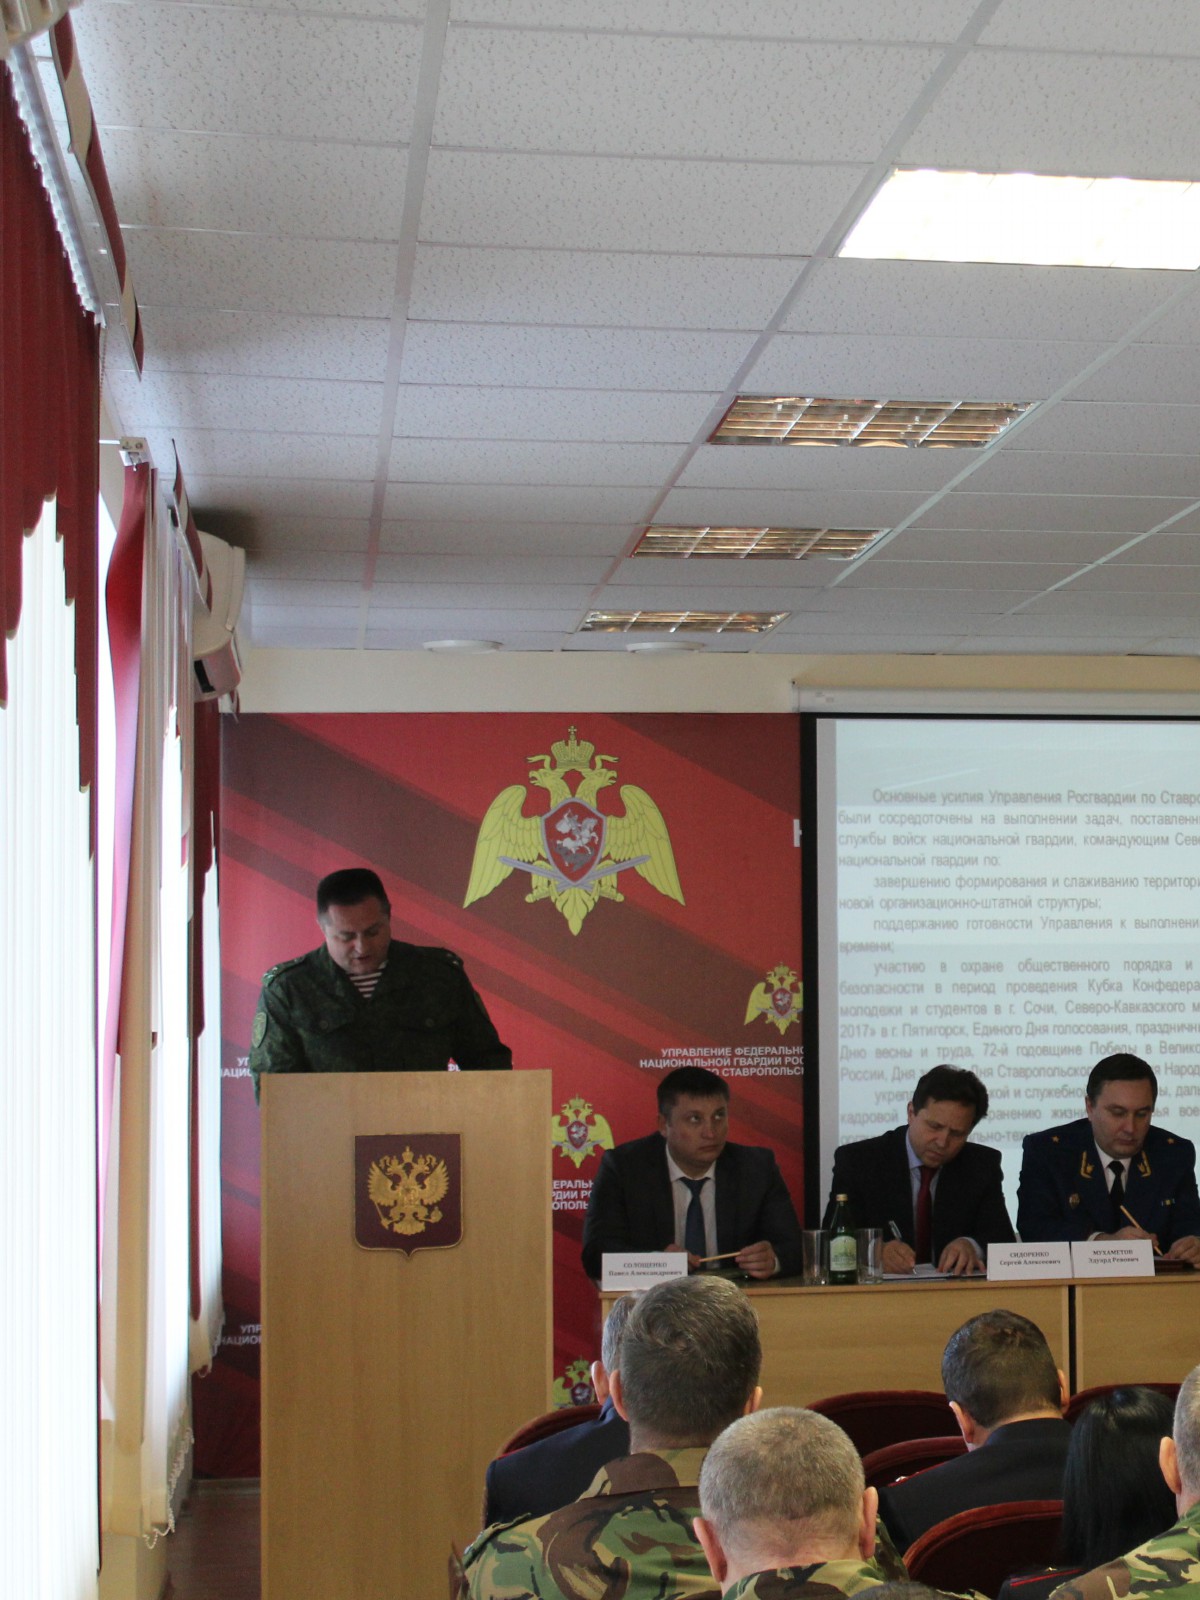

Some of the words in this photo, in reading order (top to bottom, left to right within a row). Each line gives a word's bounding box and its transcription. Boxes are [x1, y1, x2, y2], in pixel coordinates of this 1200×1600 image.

[873, 788, 936, 804] Основные
[941, 791, 984, 806] усилия
[989, 790, 1062, 806] Управления
[1067, 789, 1136, 807] Росгвардии
[1141, 793, 1156, 804] по
[838, 811, 871, 826] были
[879, 813, 973, 827] сосредоточены
[981, 814, 995, 825] на
[1004, 814, 1077, 825] выполнении
[838, 831, 886, 848] службы
[893, 831, 926, 845] войск
[933, 832, 1020, 846] национальной
[1084, 834, 1169, 849] командующим
[838, 853, 926, 867] национальной
[931, 855, 978, 868] гвардии
[873, 877, 950, 891] завершению
[956, 874, 1047, 890] формирования
[1064, 876, 1139, 888] слаживанию
[839, 897, 874, 910] новой
[874, 919, 959, 932] поддержанию
[967, 919, 1032, 930] готовности
[1041, 916, 1112, 931] Управления
[874, 962, 925, 976] участию
[961, 961, 1003, 974] охране
[1018, 956, 1110, 973] общественного
[1124, 960, 1172, 974] порядка
[839, 980, 924, 996] безопасности
[952, 982, 996, 995] период
[1006, 981, 1077, 995] проведения
[1088, 977, 1123, 995] Кубка
[840, 1005, 902, 1018] молодежи
[926, 1004, 987, 1018] студентов
[973, 1021, 1022, 1037] Единого
[1025, 1021, 1049, 1037] Дня
[661, 1048, 732, 1058] УПРАВЛЕНИЕ
[839, 1046, 866, 1061] Дню
[875, 1047, 912, 1059] весны
[1016, 1044, 1082, 1058] годовщине
[639, 1057, 730, 1069] НАЦИОНАЛЬНОЙ
[733, 1056, 782, 1067] ГВАРДИИ
[891, 1065, 914, 1082] Дня
